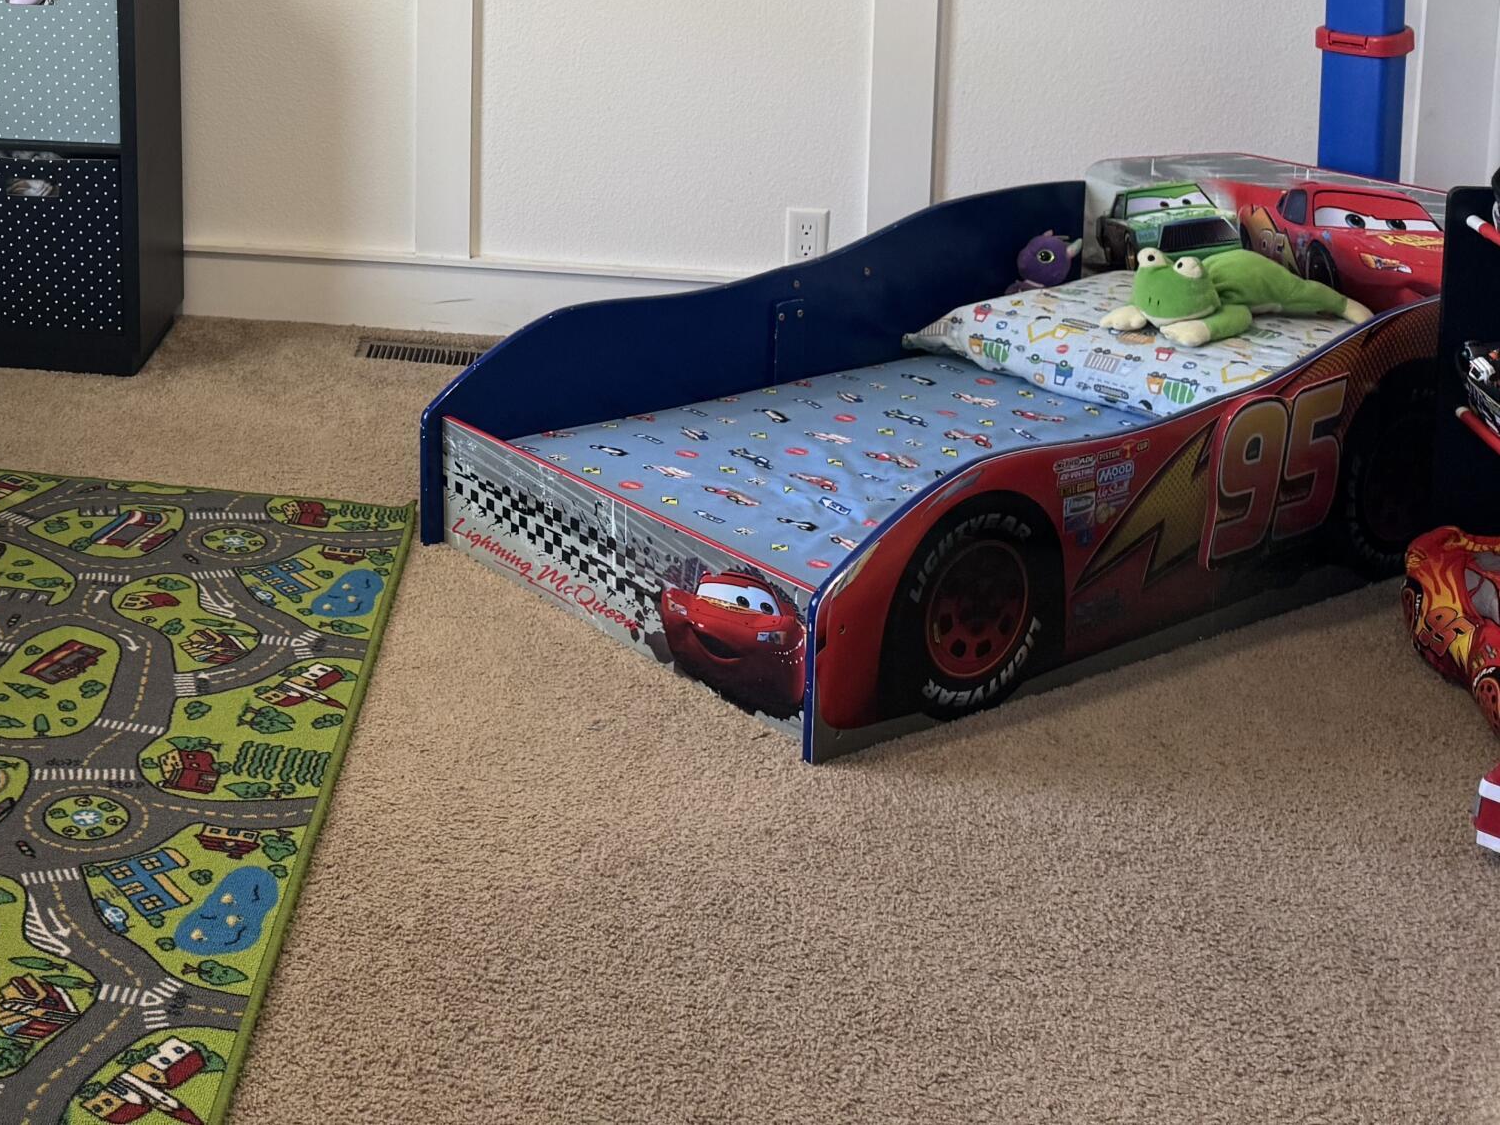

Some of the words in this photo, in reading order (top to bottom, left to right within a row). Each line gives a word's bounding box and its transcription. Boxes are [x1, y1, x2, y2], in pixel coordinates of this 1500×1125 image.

[1099, 463, 1132, 483] MOOD
[1210, 373, 1350, 560] 95
[452, 517, 533, 577] Lightning
[536, 564, 639, 632] McQueen
[909, 513, 1032, 604] LIGHTYEAR
[921, 615, 1043, 708] LIGHTYEAR
